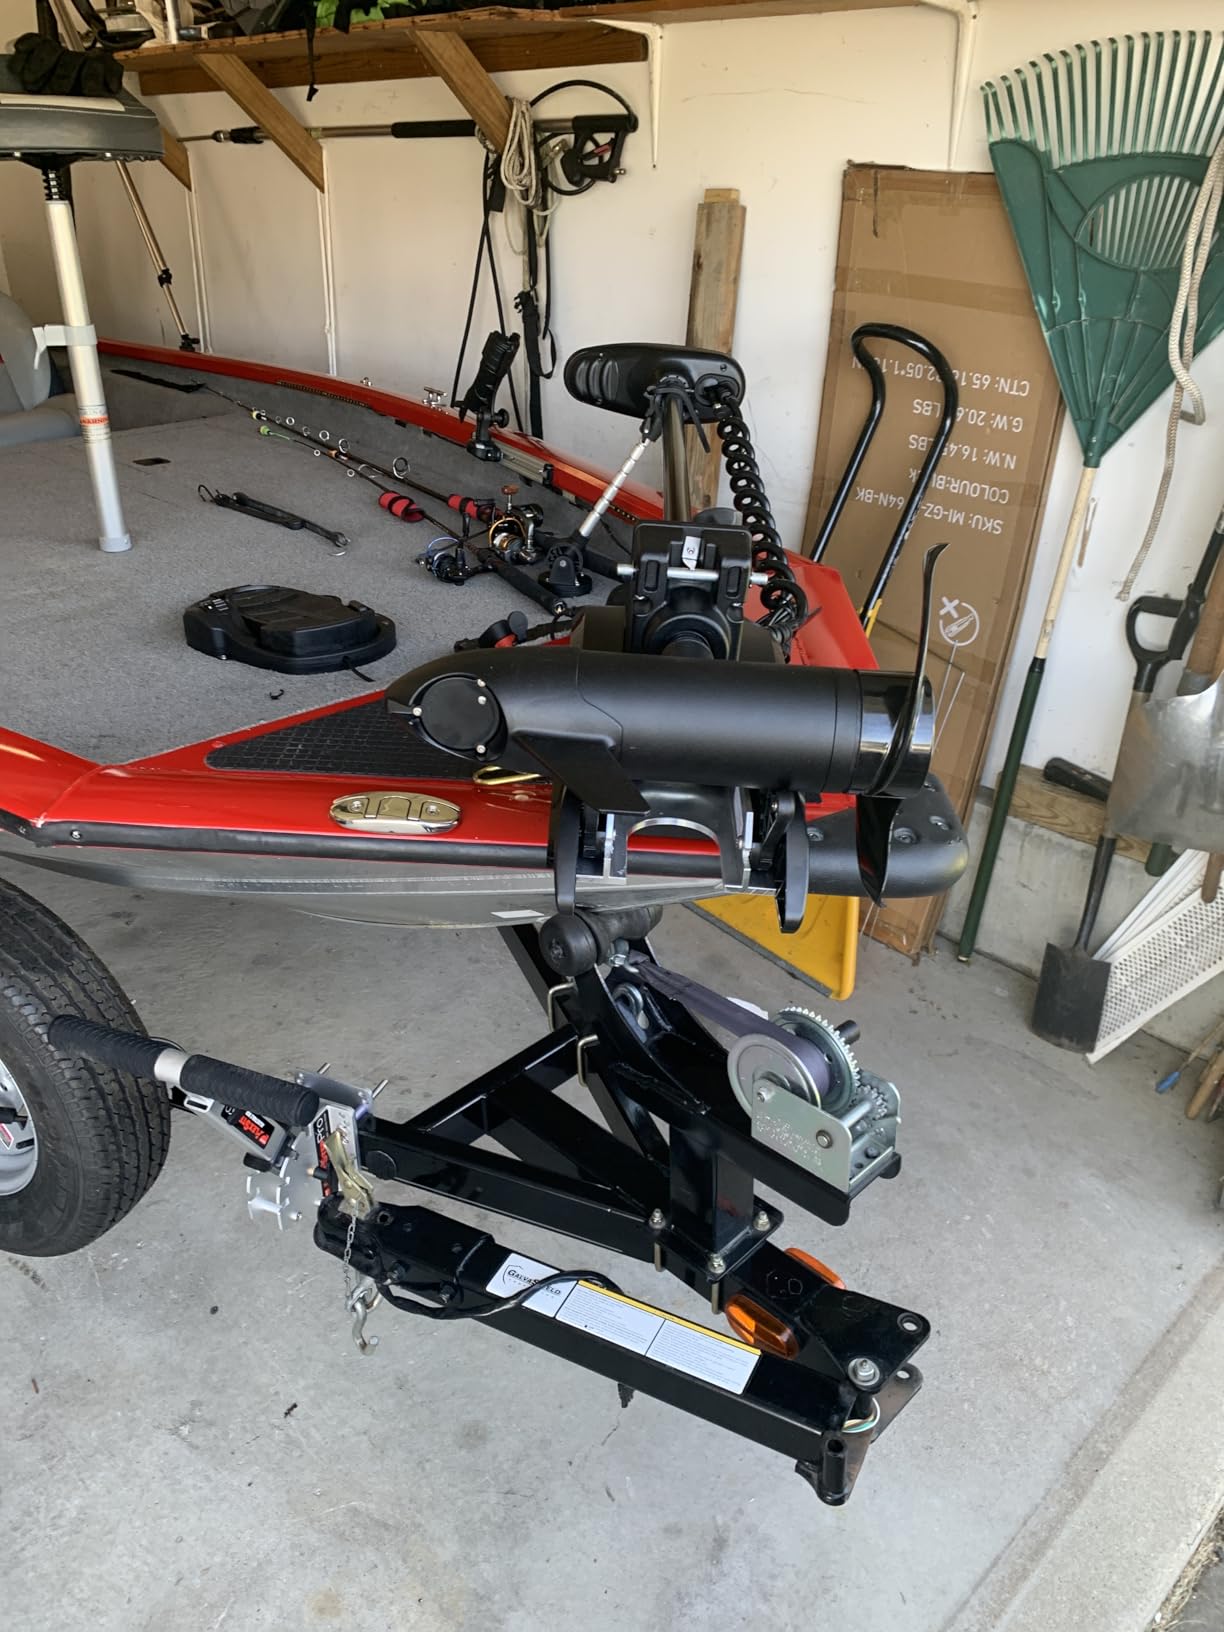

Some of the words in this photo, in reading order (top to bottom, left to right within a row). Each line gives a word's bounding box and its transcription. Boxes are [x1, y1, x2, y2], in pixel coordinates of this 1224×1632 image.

[995, 376, 1030, 397] CTN:
[912, 399, 941, 418] LBS
[956, 407, 985, 426] 20.6
[991, 413, 1023, 433] G.W:
[983, 449, 1016, 470] N.W:
[909, 468, 1009, 504] COLOUR:Blk
[968, 513, 1004, 534] SKU:
